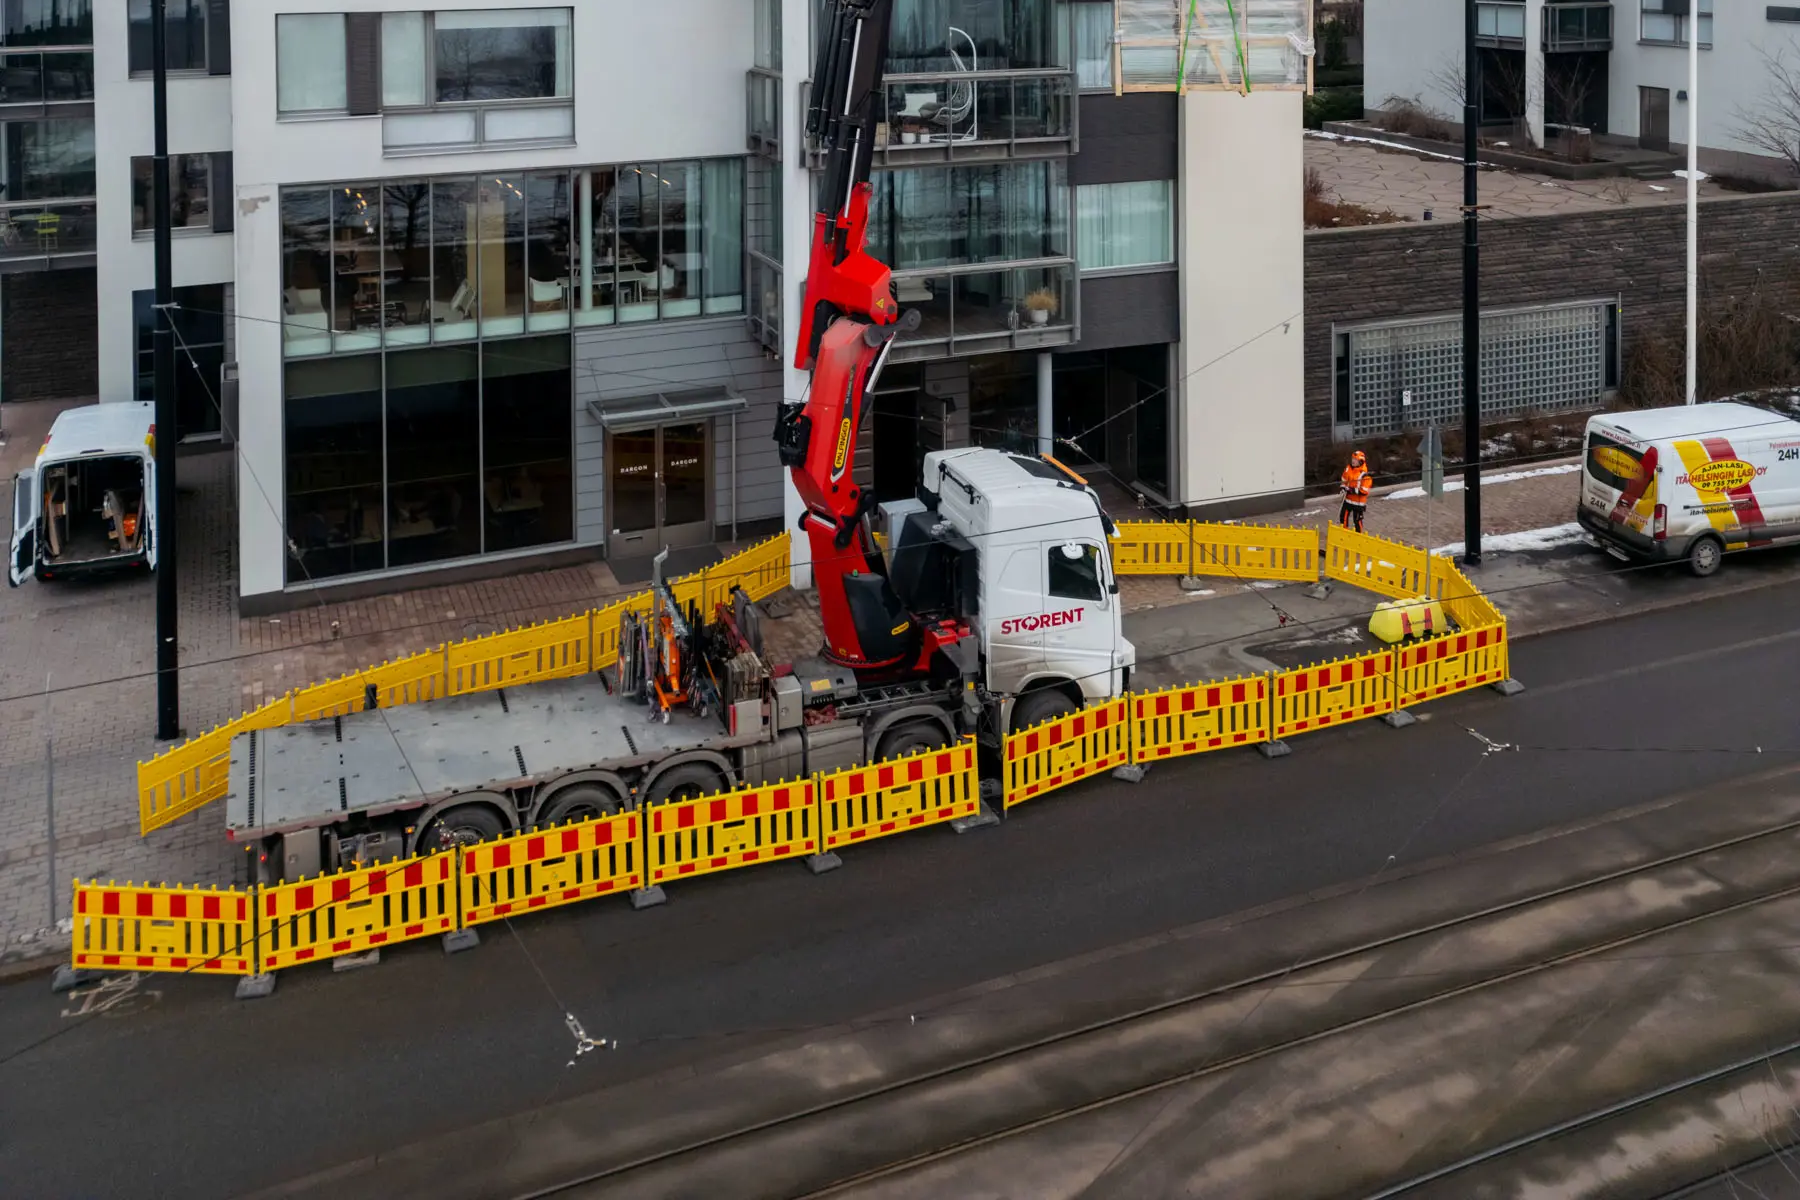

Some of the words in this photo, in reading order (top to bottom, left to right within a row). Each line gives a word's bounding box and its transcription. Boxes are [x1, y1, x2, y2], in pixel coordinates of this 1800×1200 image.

[1282, 322, 1290, 334] 7
[835, 421, 849, 465] PALFINGER
[1777, 448, 1799, 461] 24H
[1702, 462, 1743, 473] AJAN-LASI
[1737, 468, 1754, 478] LASI
[1756, 466, 1768, 476] OY
[1726, 478, 1743, 486] 7979
[1590, 497, 1606, 511] 24H
[1001, 607, 1085, 634] STORENT
